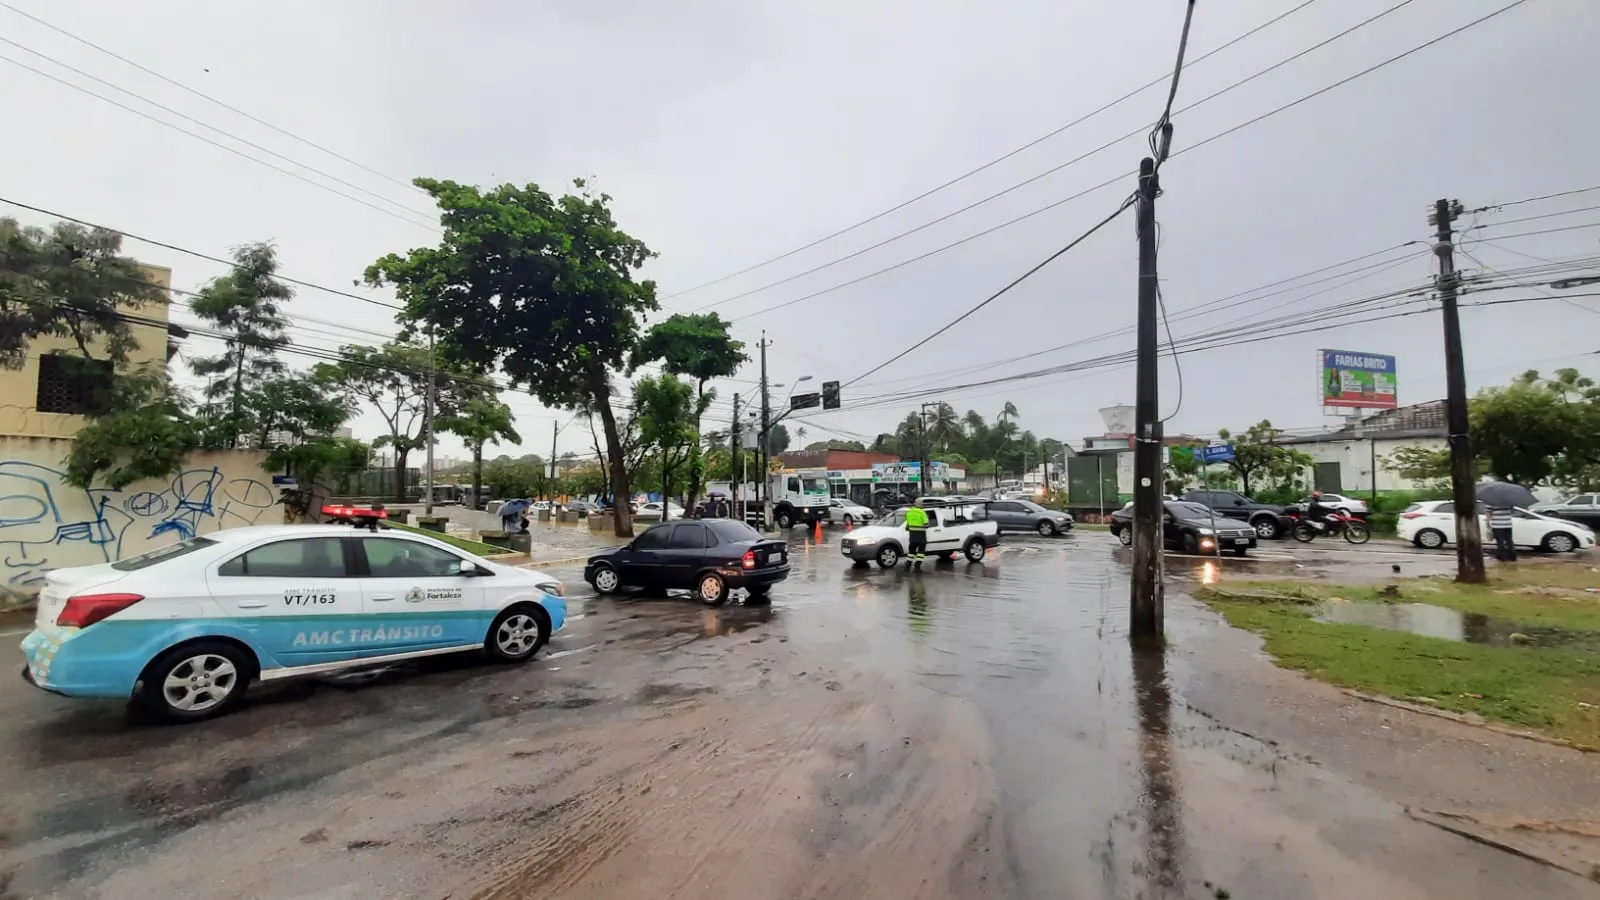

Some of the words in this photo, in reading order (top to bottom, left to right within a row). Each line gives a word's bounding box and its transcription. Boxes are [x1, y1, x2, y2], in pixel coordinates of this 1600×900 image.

[1335, 354, 1363, 368] FARIAS
[1363, 357, 1386, 369] BRITO
[284, 594, 336, 606] VT/163
[427, 592, 462, 600] Fortaleza
[292, 630, 344, 647] AMC
[350, 624, 443, 642] TRÂNSITO
